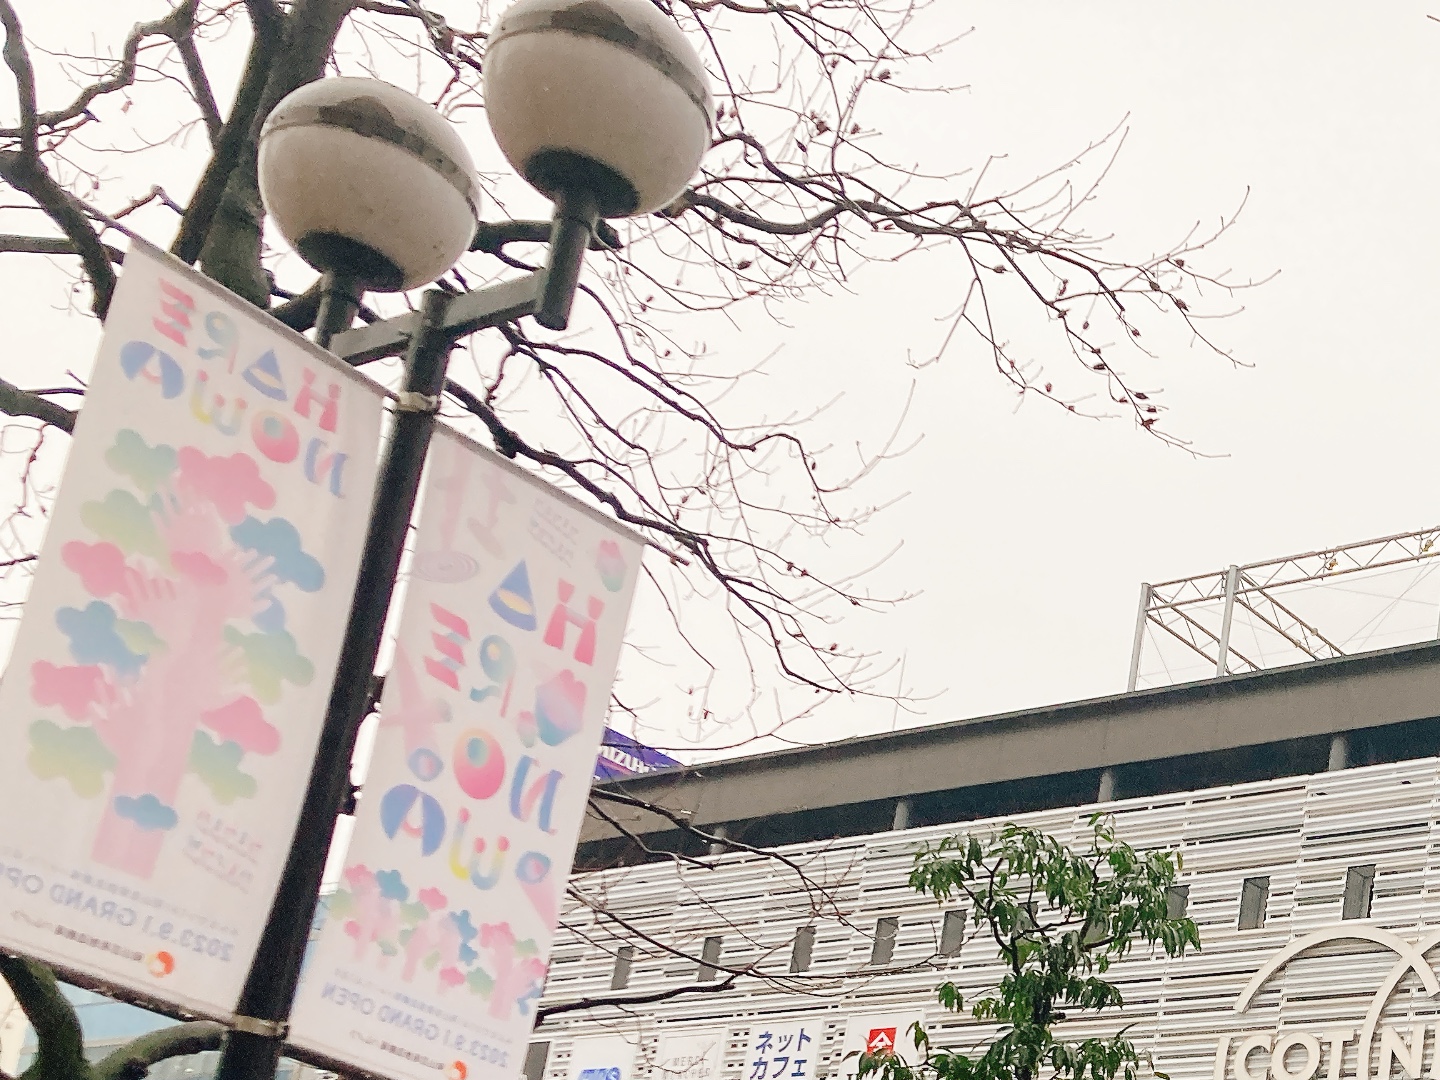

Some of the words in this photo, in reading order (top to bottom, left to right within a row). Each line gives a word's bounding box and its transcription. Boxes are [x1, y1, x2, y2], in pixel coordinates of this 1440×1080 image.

[755, 1027, 812, 1054] ネット
[749, 1056, 808, 1080] カフェ
